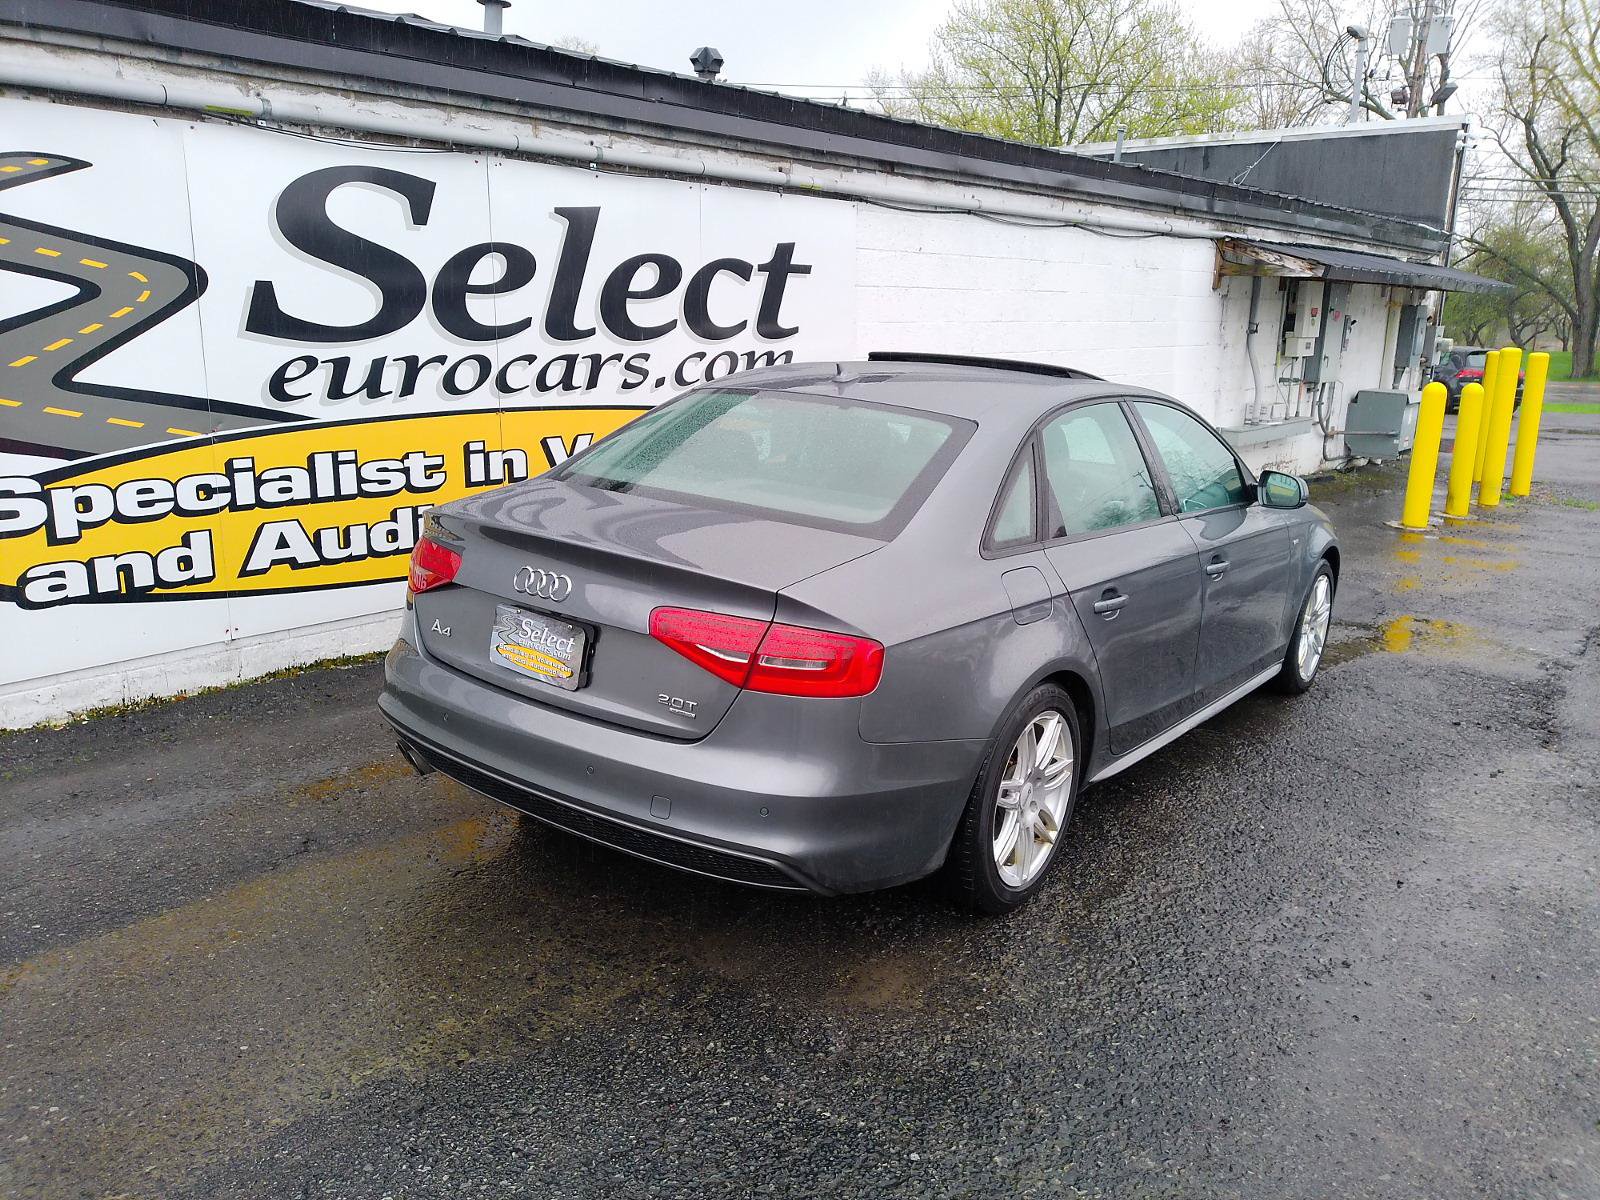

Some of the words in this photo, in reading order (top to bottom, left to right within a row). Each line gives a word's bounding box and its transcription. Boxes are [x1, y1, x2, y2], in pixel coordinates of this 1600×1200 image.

[243, 165, 812, 343] Select
[0, 449, 447, 546] Specialist
[463, 440, 529, 488] in
[16, 528, 216, 610] and
[431, 618, 452, 638] A4
[518, 617, 576, 653] Select
[658, 693, 698, 711] 2.0T
